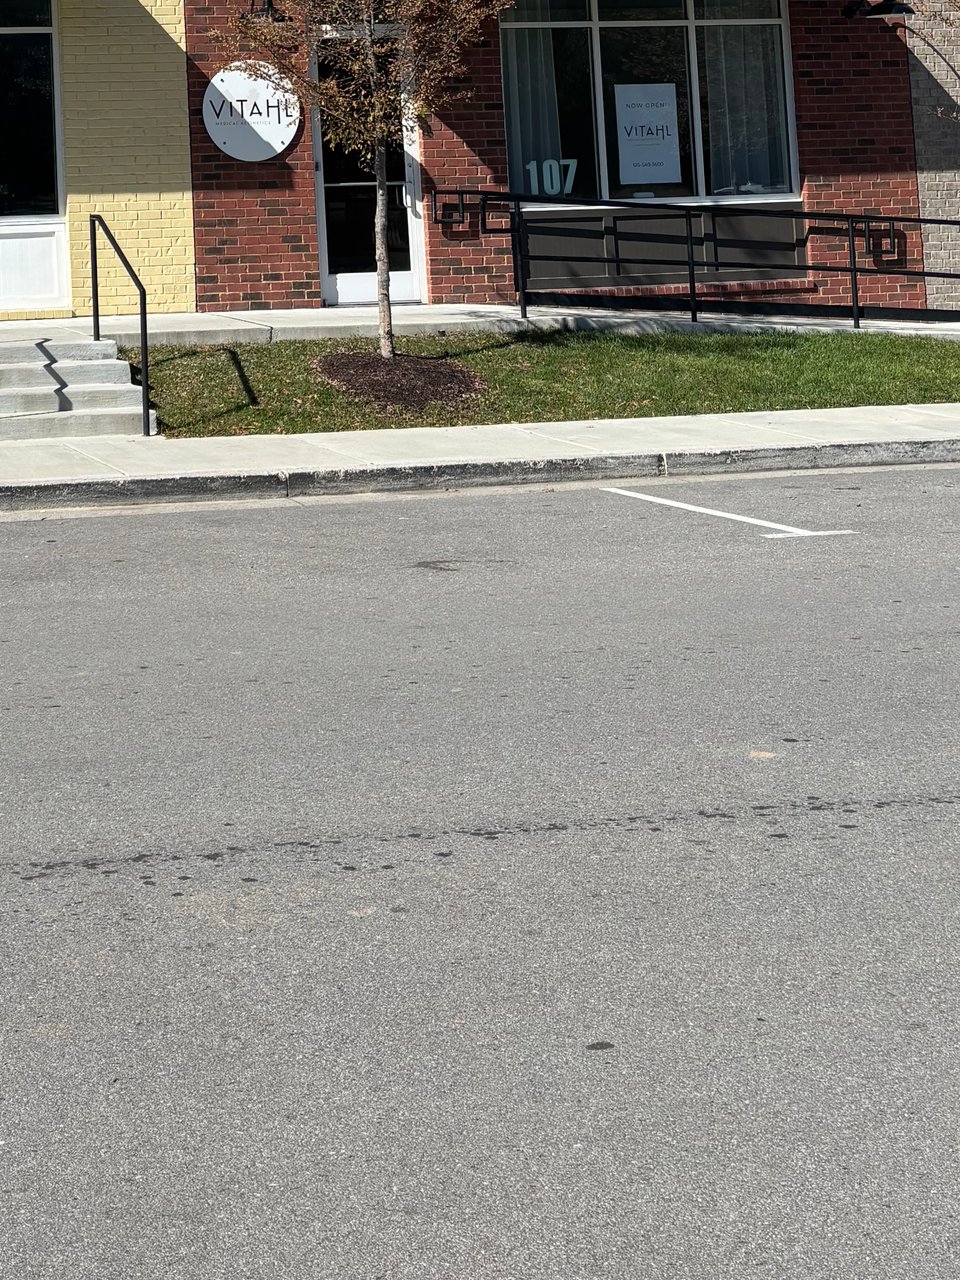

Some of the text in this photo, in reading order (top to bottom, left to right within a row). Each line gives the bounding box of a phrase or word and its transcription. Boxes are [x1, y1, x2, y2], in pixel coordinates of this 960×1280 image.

[209, 99, 293, 125] VITAHL
[623, 125, 672, 140] VITAHL
[525, 158, 578, 196] 107
